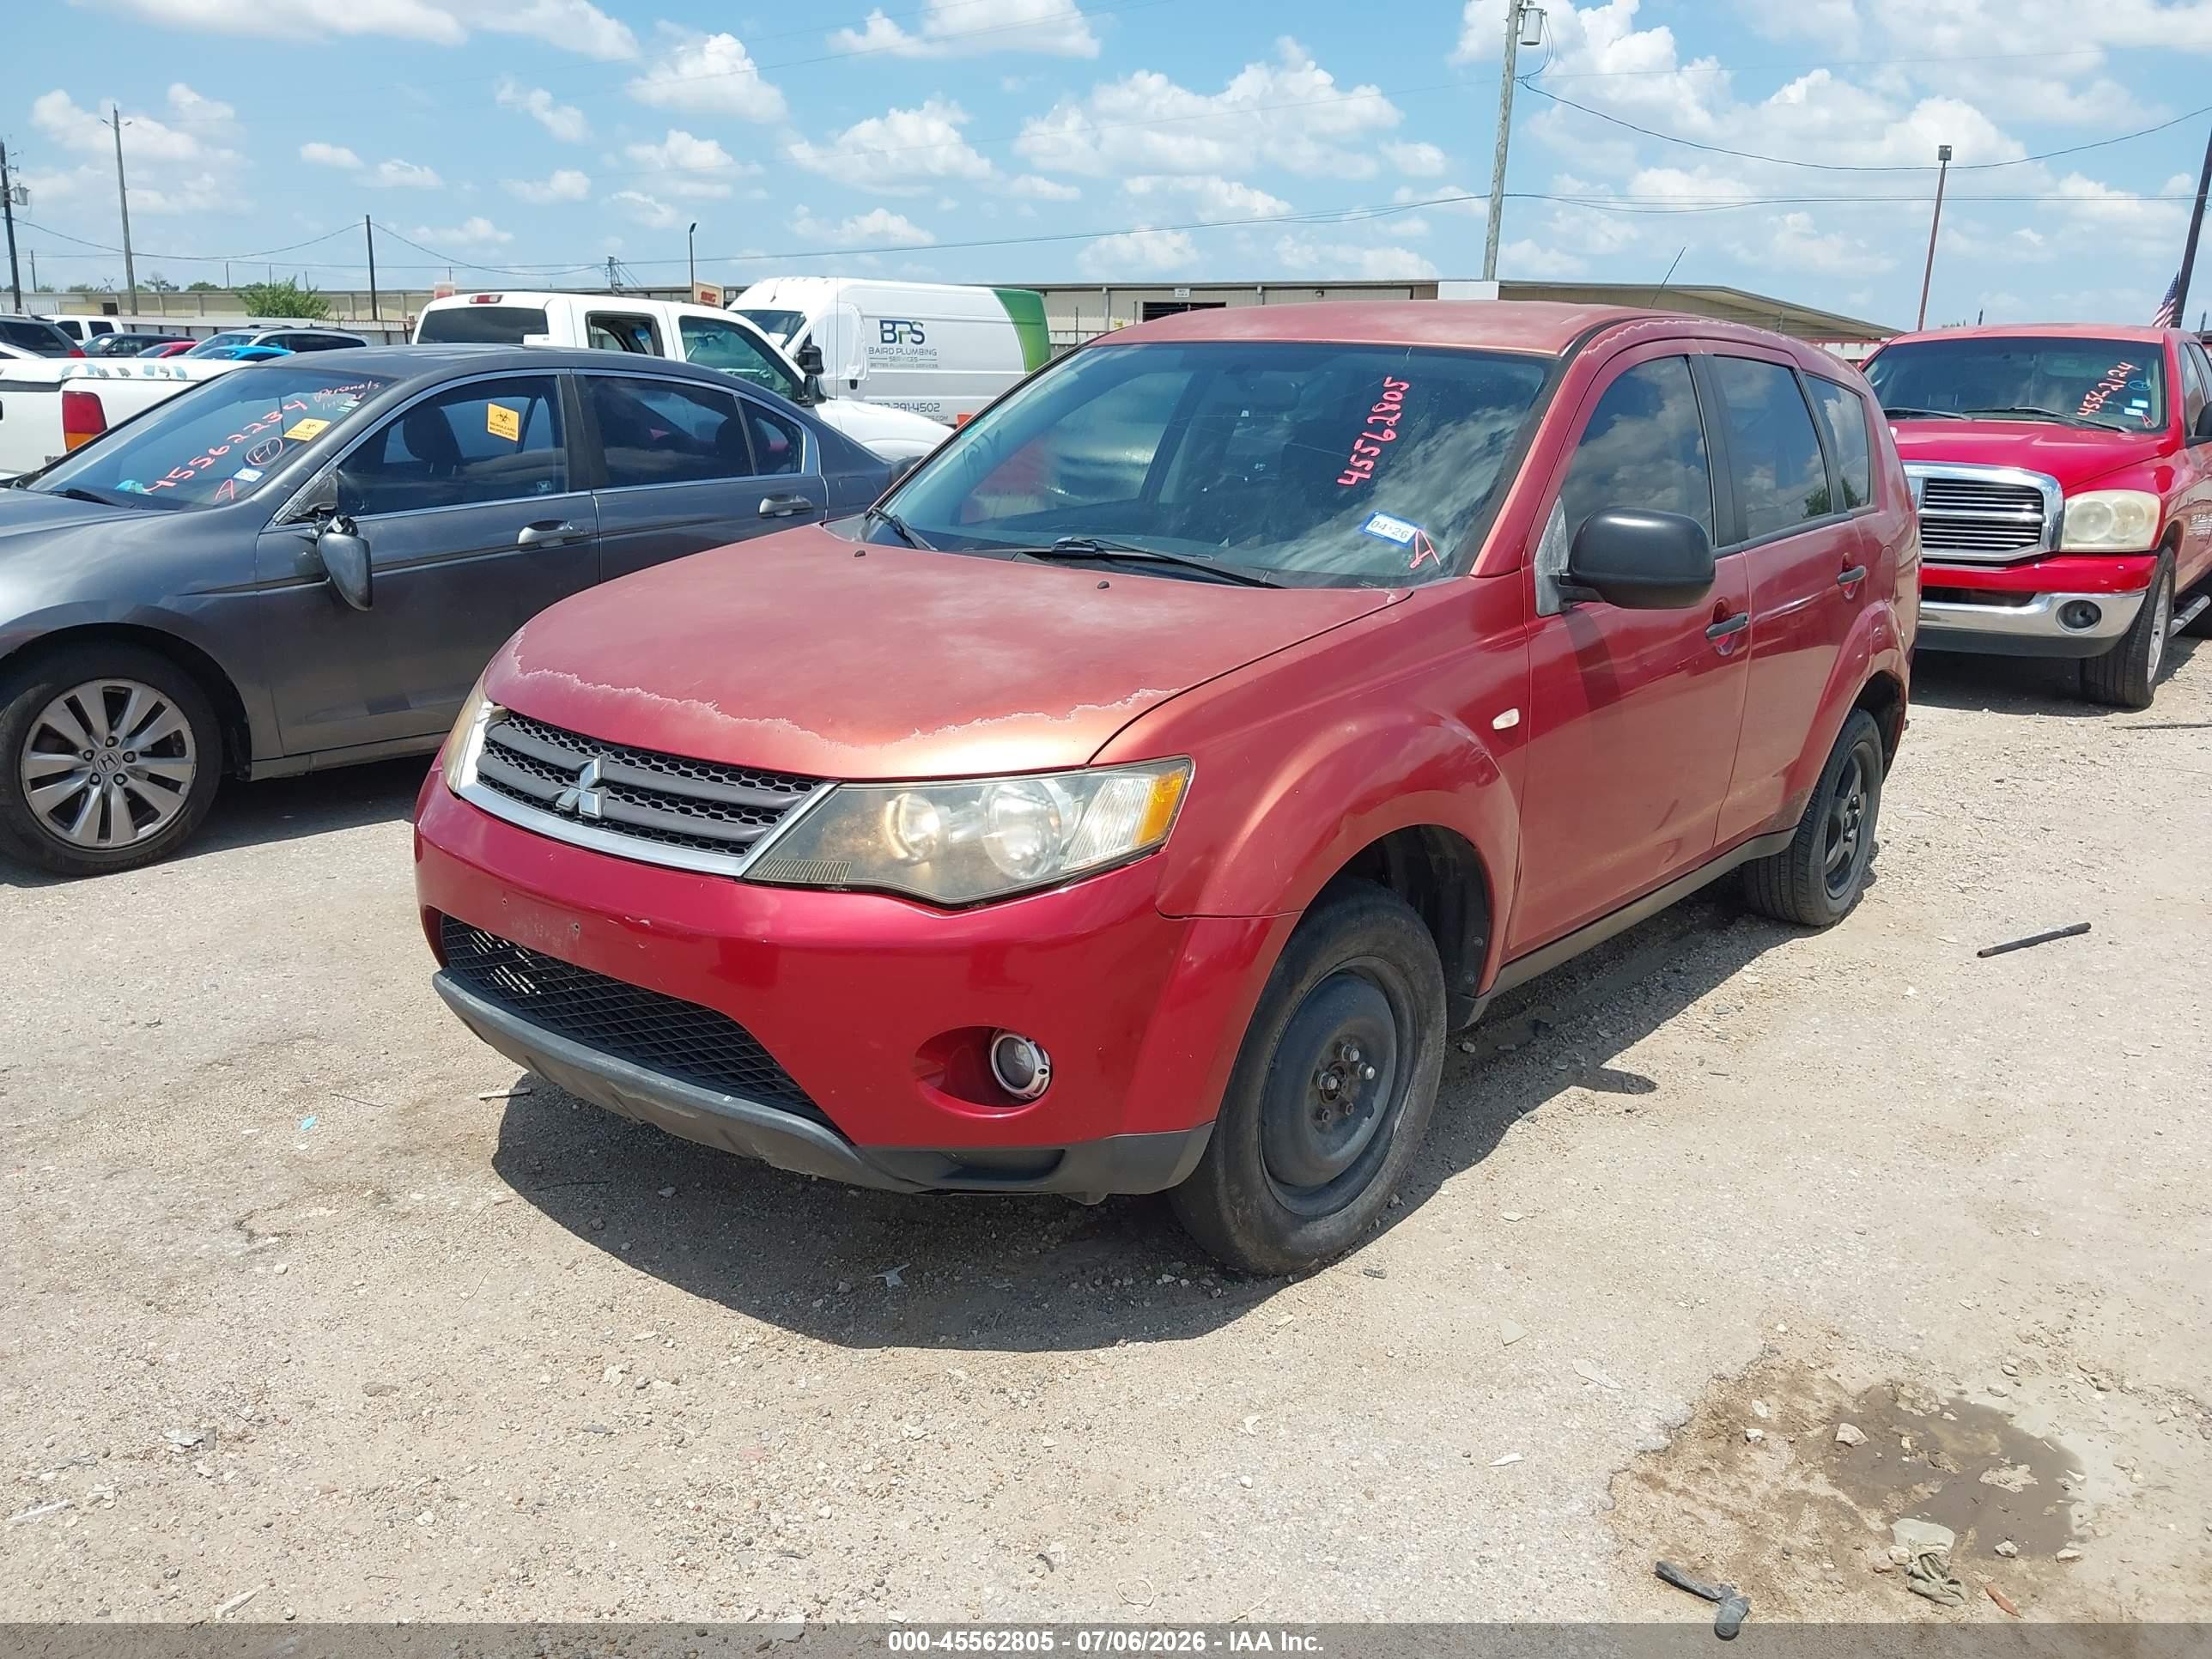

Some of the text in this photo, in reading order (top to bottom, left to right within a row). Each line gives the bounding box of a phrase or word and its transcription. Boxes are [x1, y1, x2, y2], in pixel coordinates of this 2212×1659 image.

[879, 319, 925, 345] BPS
[896, 348, 937, 356] PLUMBING
[144, 400, 308, 493] 45562234
[1337, 376, 1410, 485] 45562805
